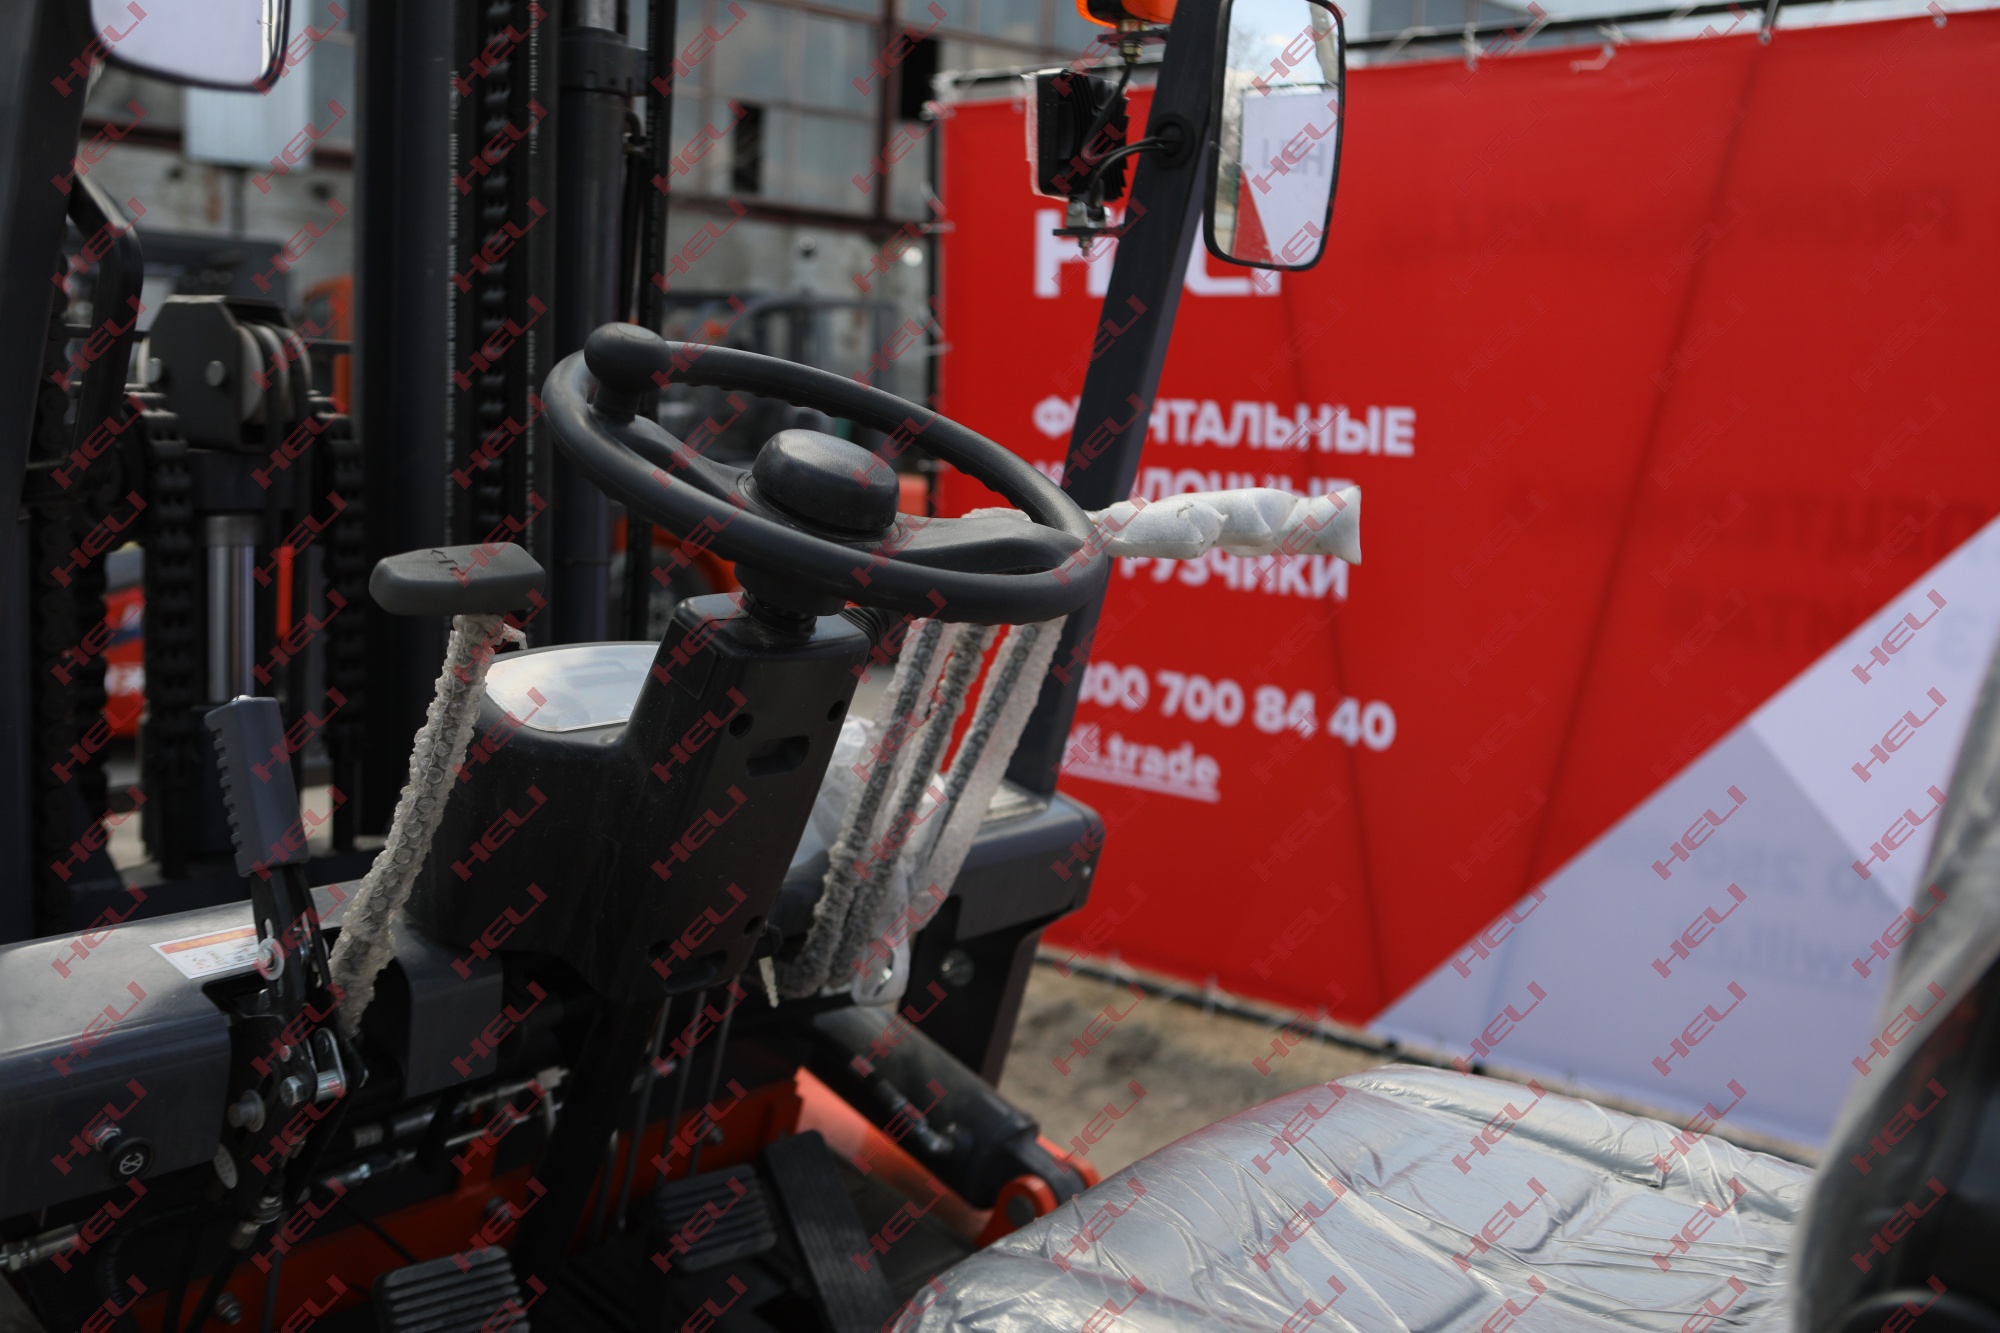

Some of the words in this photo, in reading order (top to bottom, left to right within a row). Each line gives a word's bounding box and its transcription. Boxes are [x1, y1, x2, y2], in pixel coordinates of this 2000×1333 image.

[529, 0, 539, 56] PRESSU
[1034, 208, 1281, 297] HL
[1033, 395, 1416, 457] ФНТАЛЬНЫЕ
[1156, 669, 1246, 727] 700
[1253, 684, 1318, 739] 84
[1328, 696, 1397, 752] 40
